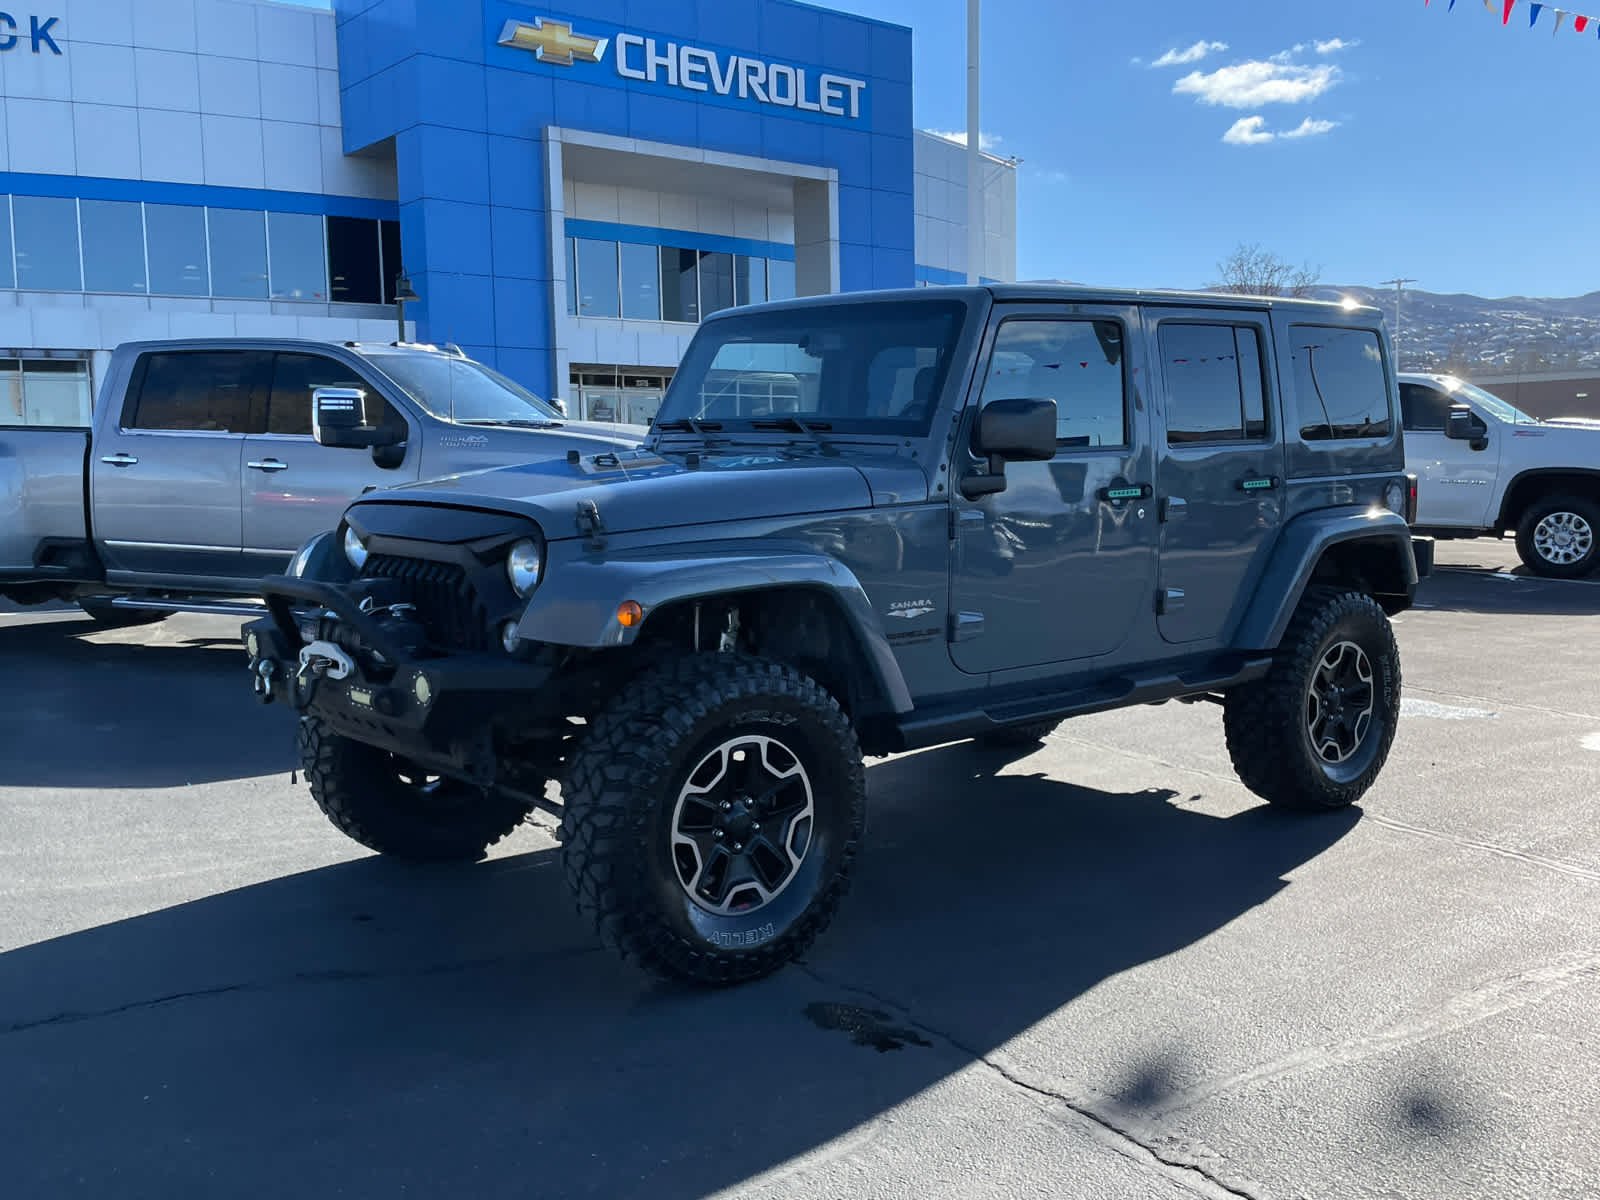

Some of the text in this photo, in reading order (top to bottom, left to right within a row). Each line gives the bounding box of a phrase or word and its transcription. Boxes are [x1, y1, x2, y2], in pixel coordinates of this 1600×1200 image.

[616, 33, 865, 117] CHEVROLET
[890, 599, 932, 610] SAHARA
[706, 922, 775, 946] KELLY
